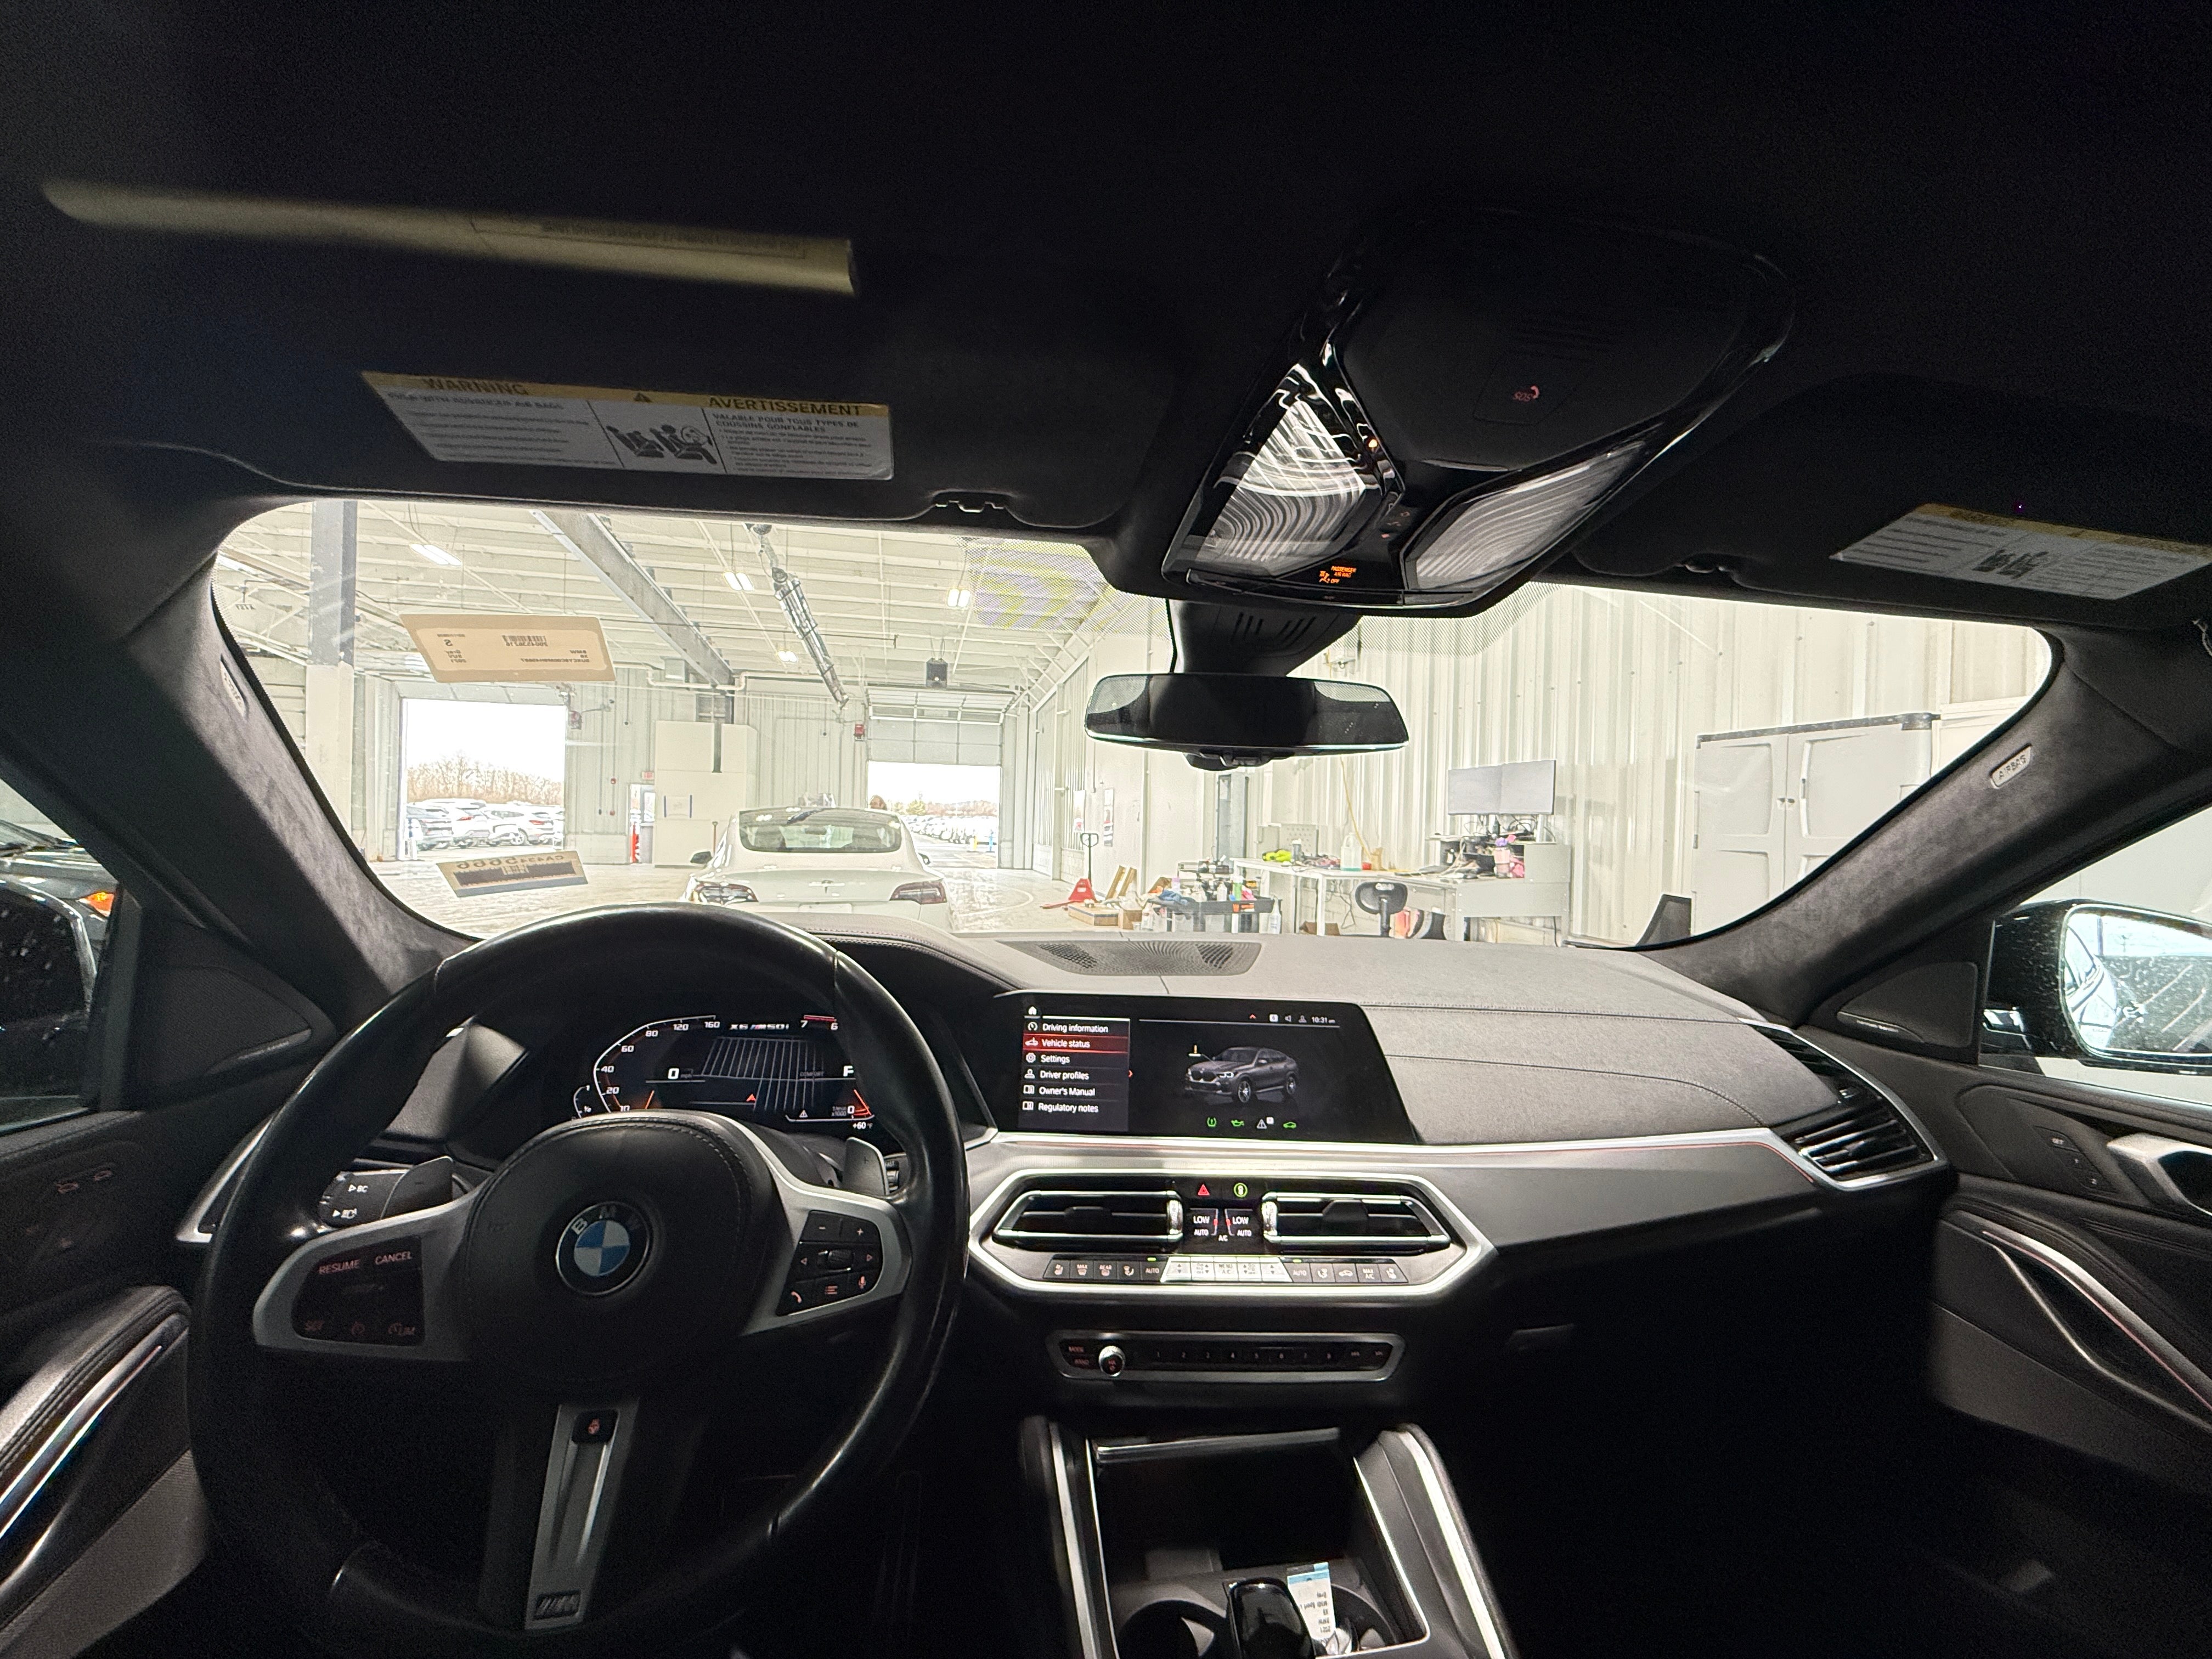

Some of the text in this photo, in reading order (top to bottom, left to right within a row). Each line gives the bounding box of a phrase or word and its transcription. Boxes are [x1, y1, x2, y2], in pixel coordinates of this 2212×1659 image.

[423, 378, 529, 396] WARNING
[709, 396, 862, 416] AVERTISSEMENT
[713, 413, 754, 422] VALABLE
[758, 416, 785, 424] POUR
[816, 419, 844, 427] TYPES
[715, 420, 826, 433] COUSSINS GONFLABLES
[1042, 1023, 1109, 1033] Driving information
[1042, 1039, 1090, 1048] Vehicle status
[1041, 1054, 1070, 1064] Settings
[668, 1068, 679, 1080] 0
[1040, 1070, 1090, 1081] Driver profiles
[1039, 1086, 1096, 1096] Owner's Manual
[847, 1105, 855, 1114] 0
[1038, 1102, 1099, 1113] Regulatory notes
[853, 1121, 867, 1130] +60
[1193, 1215, 1210, 1223] LOW
[1232, 1216, 1249, 1224] LOW
[374, 1251, 412, 1265] CANCEL
[318, 1259, 361, 1275] RESUME
